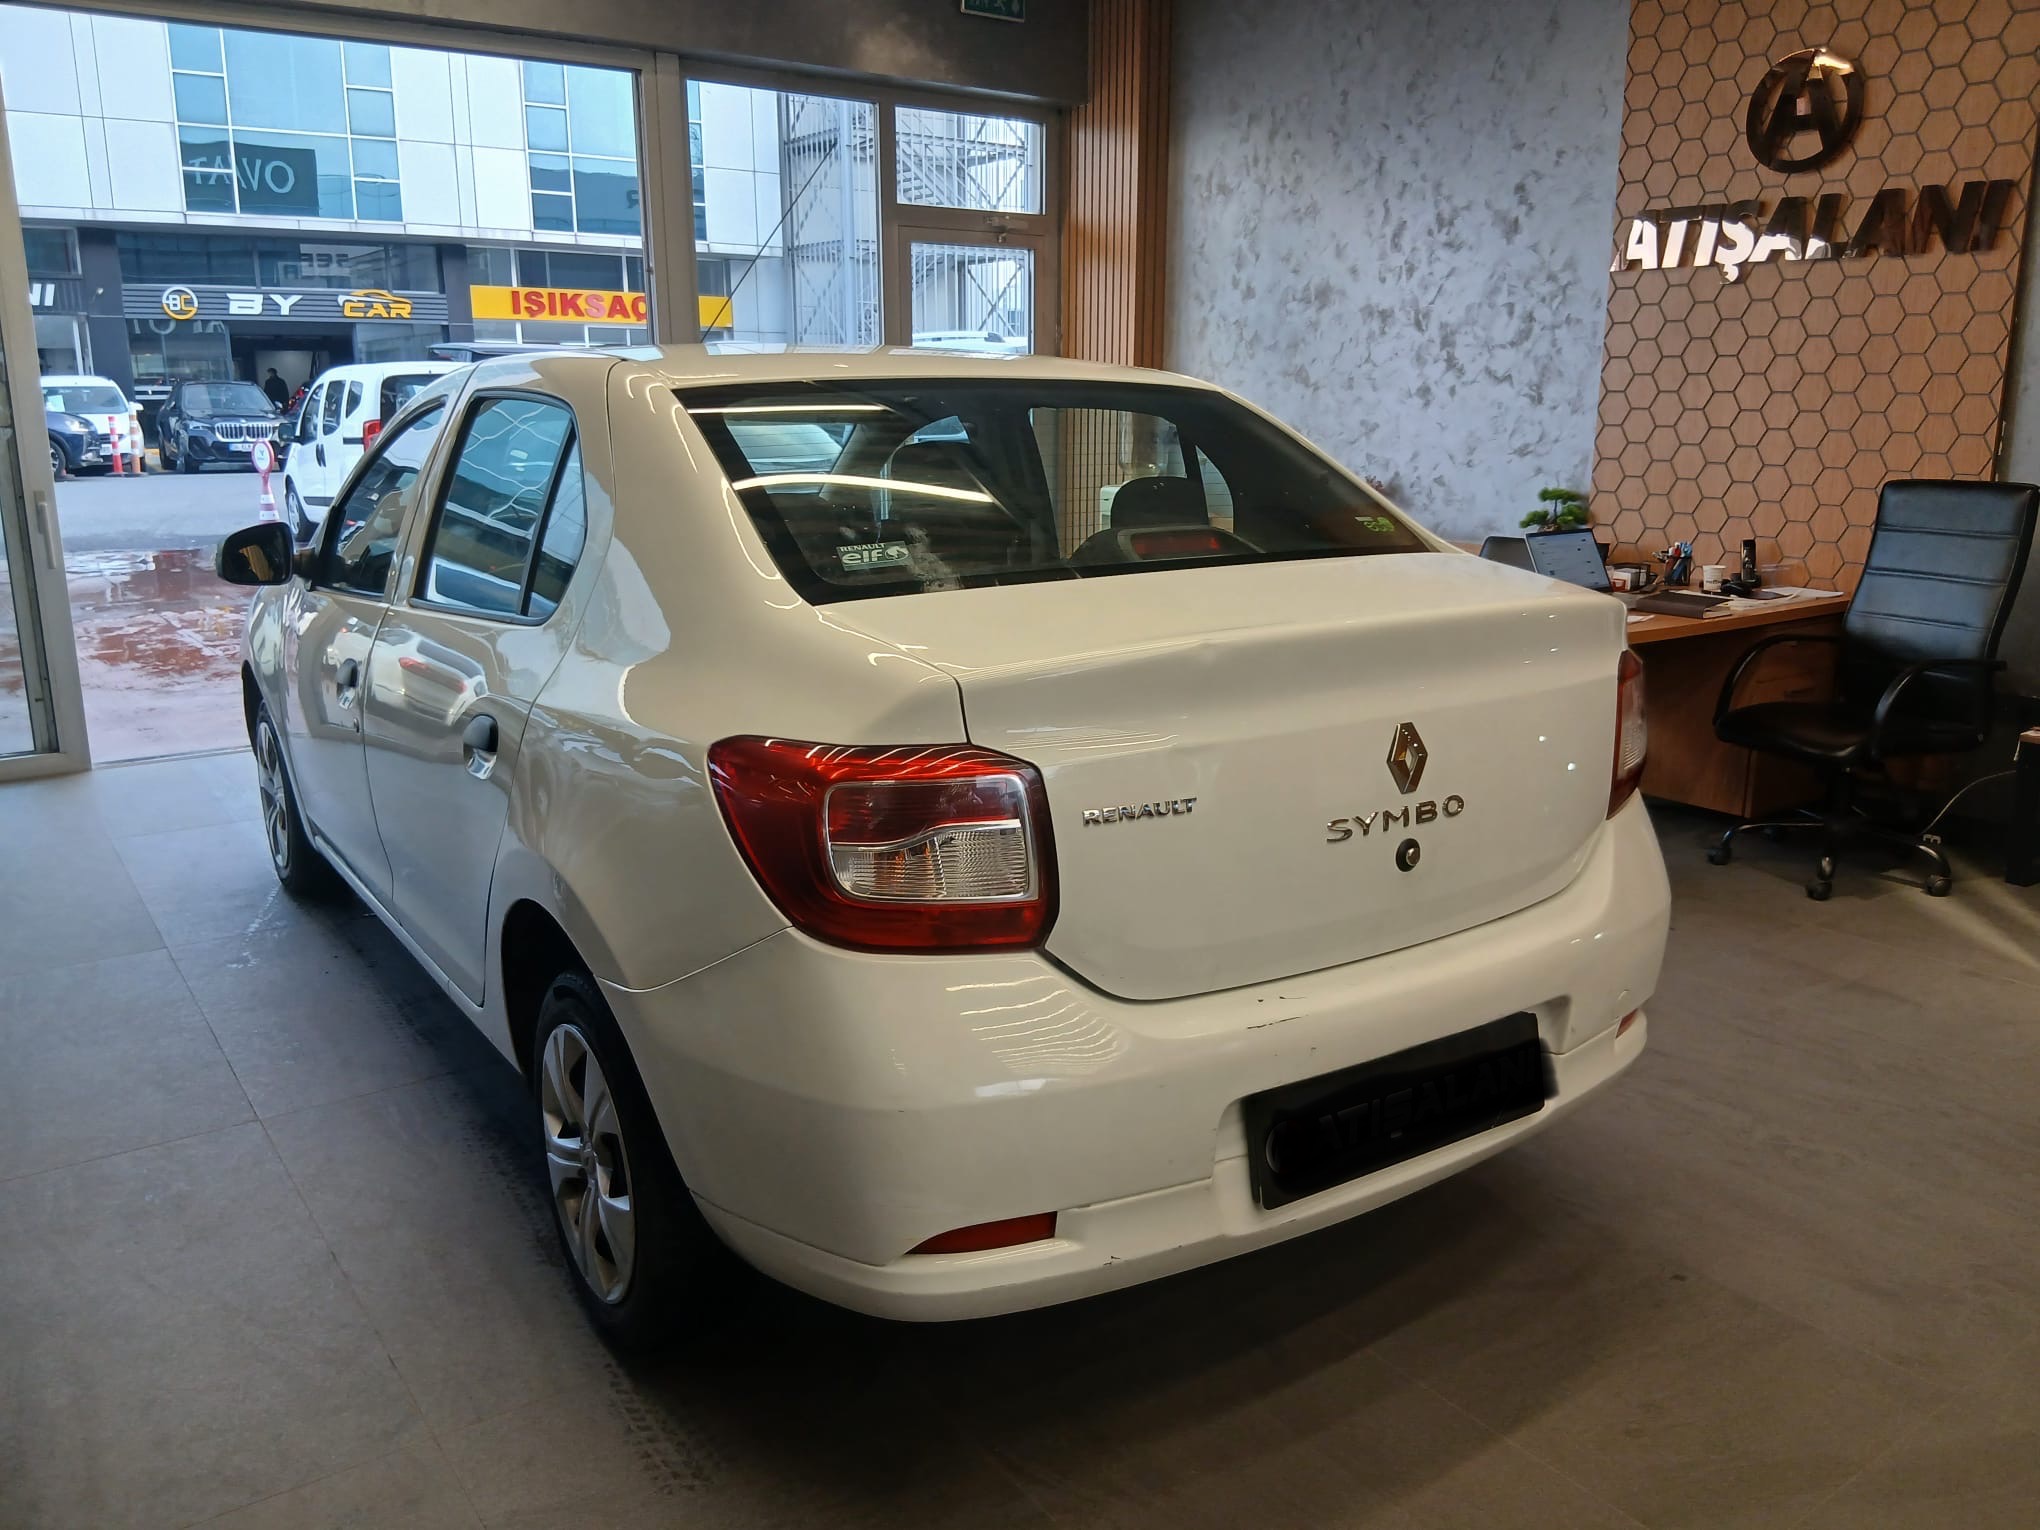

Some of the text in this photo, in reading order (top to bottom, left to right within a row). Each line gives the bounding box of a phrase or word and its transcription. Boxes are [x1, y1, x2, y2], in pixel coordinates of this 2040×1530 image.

[1610, 179, 2014, 284] ATIŞALANI
[226, 293, 412, 319] BY CAR
[840, 543, 885, 552] RENAULT
[842, 549, 883, 563] elf
[1082, 797, 1197, 826] RENAULT
[1326, 794, 1464, 843] SYMBO
